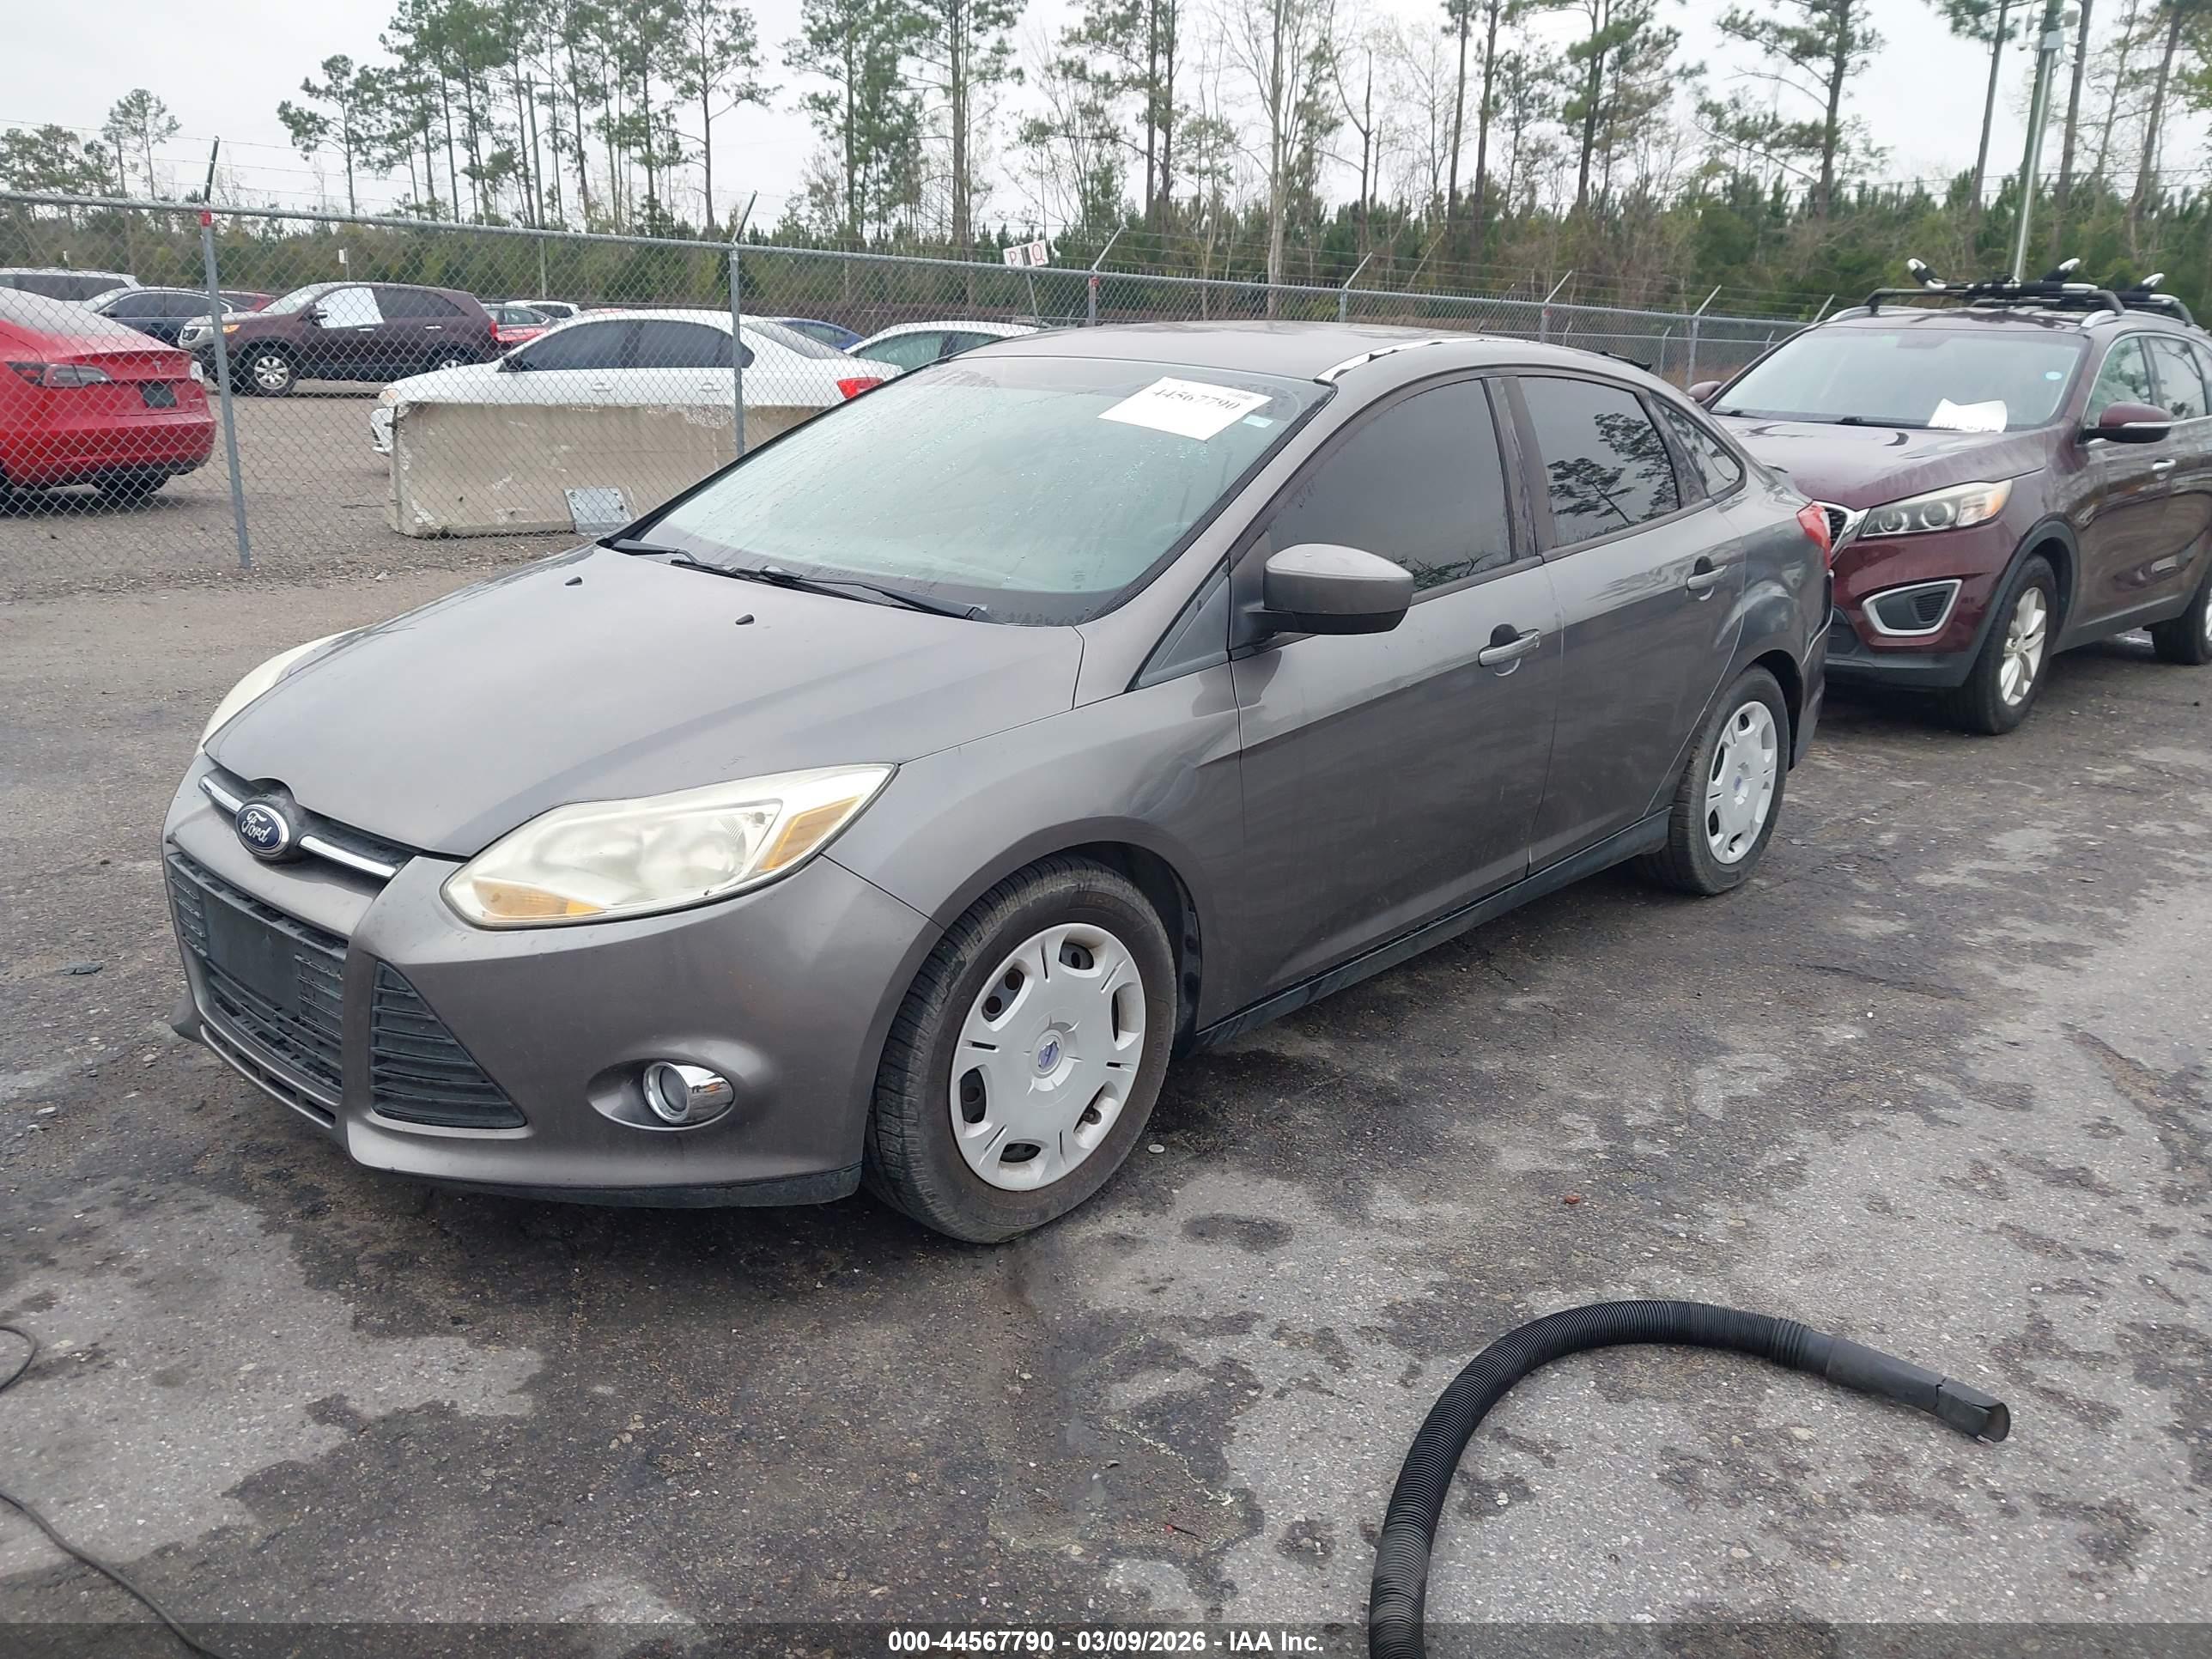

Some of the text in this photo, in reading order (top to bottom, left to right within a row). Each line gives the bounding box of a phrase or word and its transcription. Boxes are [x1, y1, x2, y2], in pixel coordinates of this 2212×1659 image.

[1032, 244, 1045, 263] Q
[1152, 388, 1241, 410] 44567790
[241, 811, 272, 843] Ford
